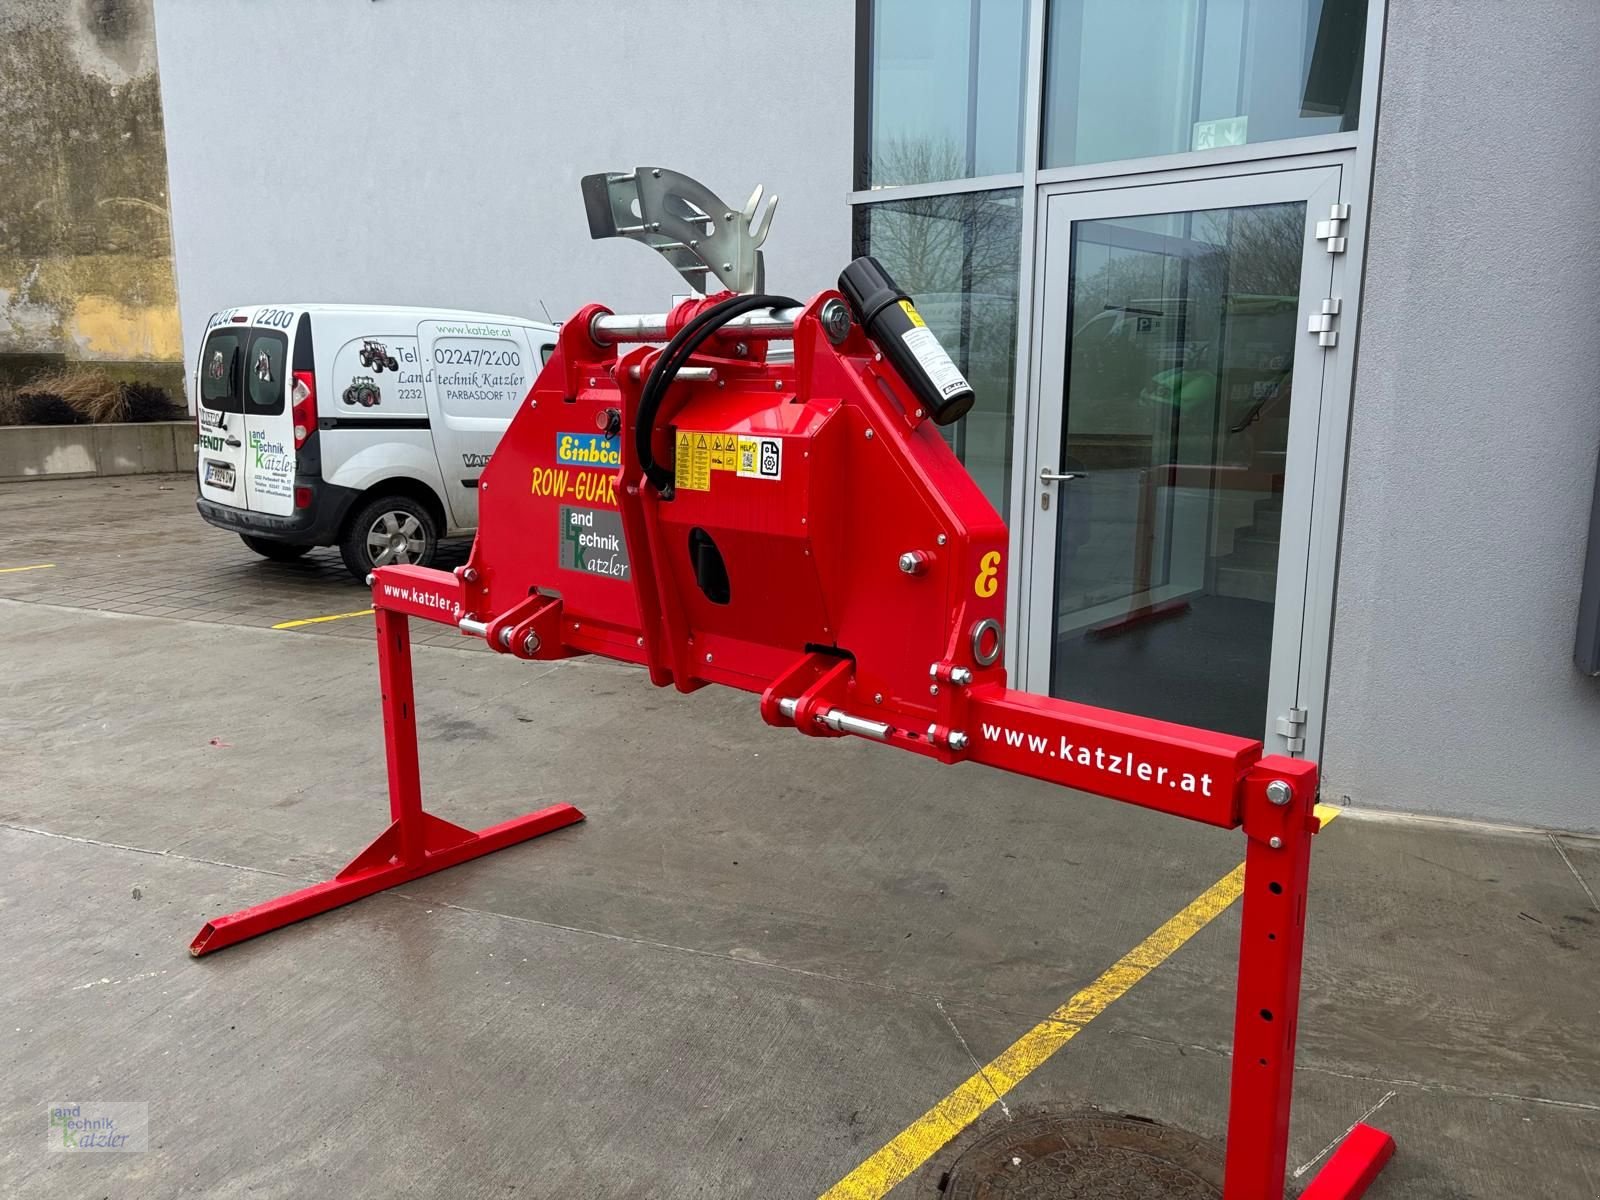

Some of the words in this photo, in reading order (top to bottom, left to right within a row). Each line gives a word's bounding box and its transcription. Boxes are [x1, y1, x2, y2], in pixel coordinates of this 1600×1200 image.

[256, 309, 294, 329] 2200
[436, 324, 512, 337] www.katzler.at
[434, 349, 520, 367] 02247/2200
[438, 371, 481, 388] technik
[481, 373, 525, 387] Katzler
[398, 389, 423, 399] 2232
[447, 391, 503, 401] PARBASDORF
[507, 392, 517, 401] 17
[200, 434, 225, 452] FENDT
[559, 436, 621, 464] Einböc
[531, 467, 618, 506] ROW-GUAR
[384, 584, 460, 613] www.katzler.a
[981, 722, 1213, 797] www.katzler.at
